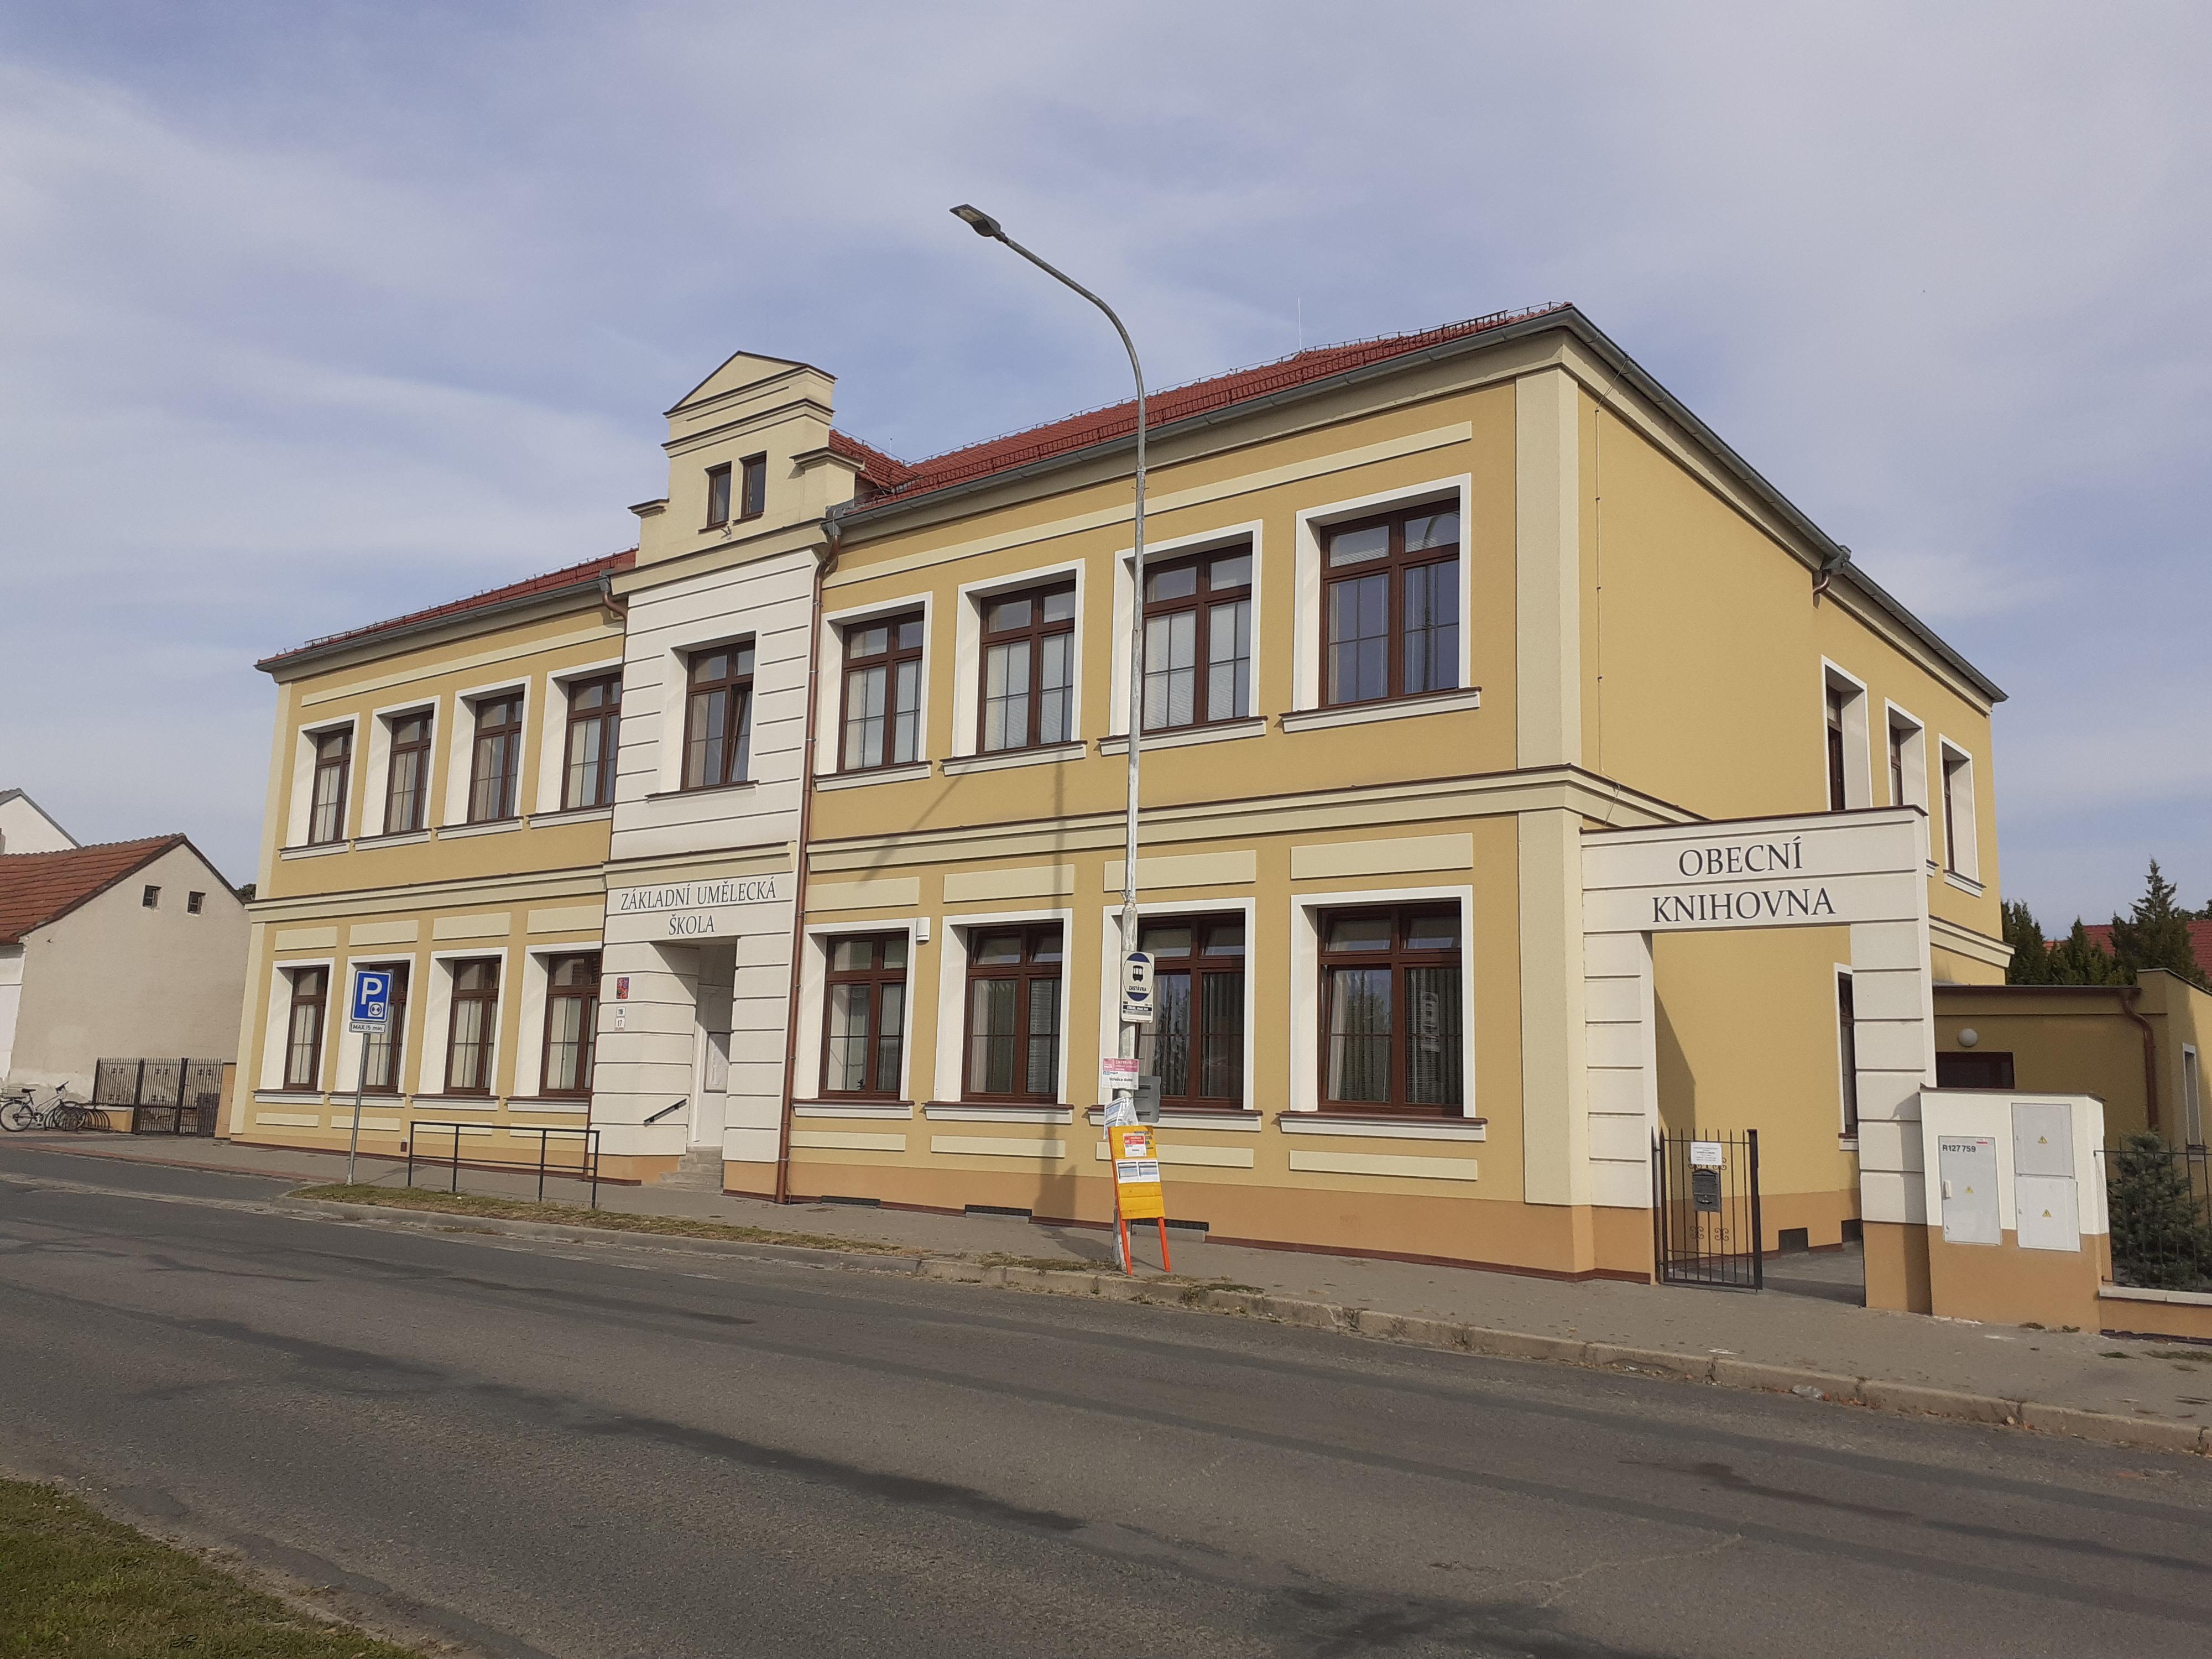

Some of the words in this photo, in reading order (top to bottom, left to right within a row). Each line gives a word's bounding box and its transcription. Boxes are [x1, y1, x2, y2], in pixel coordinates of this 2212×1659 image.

[1678, 836, 1803, 877] OBECNÍ
[620, 884, 691, 911] ZÁKLADNÍ
[697, 877, 777, 905] UMĚLECKÁ
[1652, 887, 1836, 923] KNIHOVNA
[668, 914, 715, 936] ŠKOLA
[361, 977, 383, 1005] P
